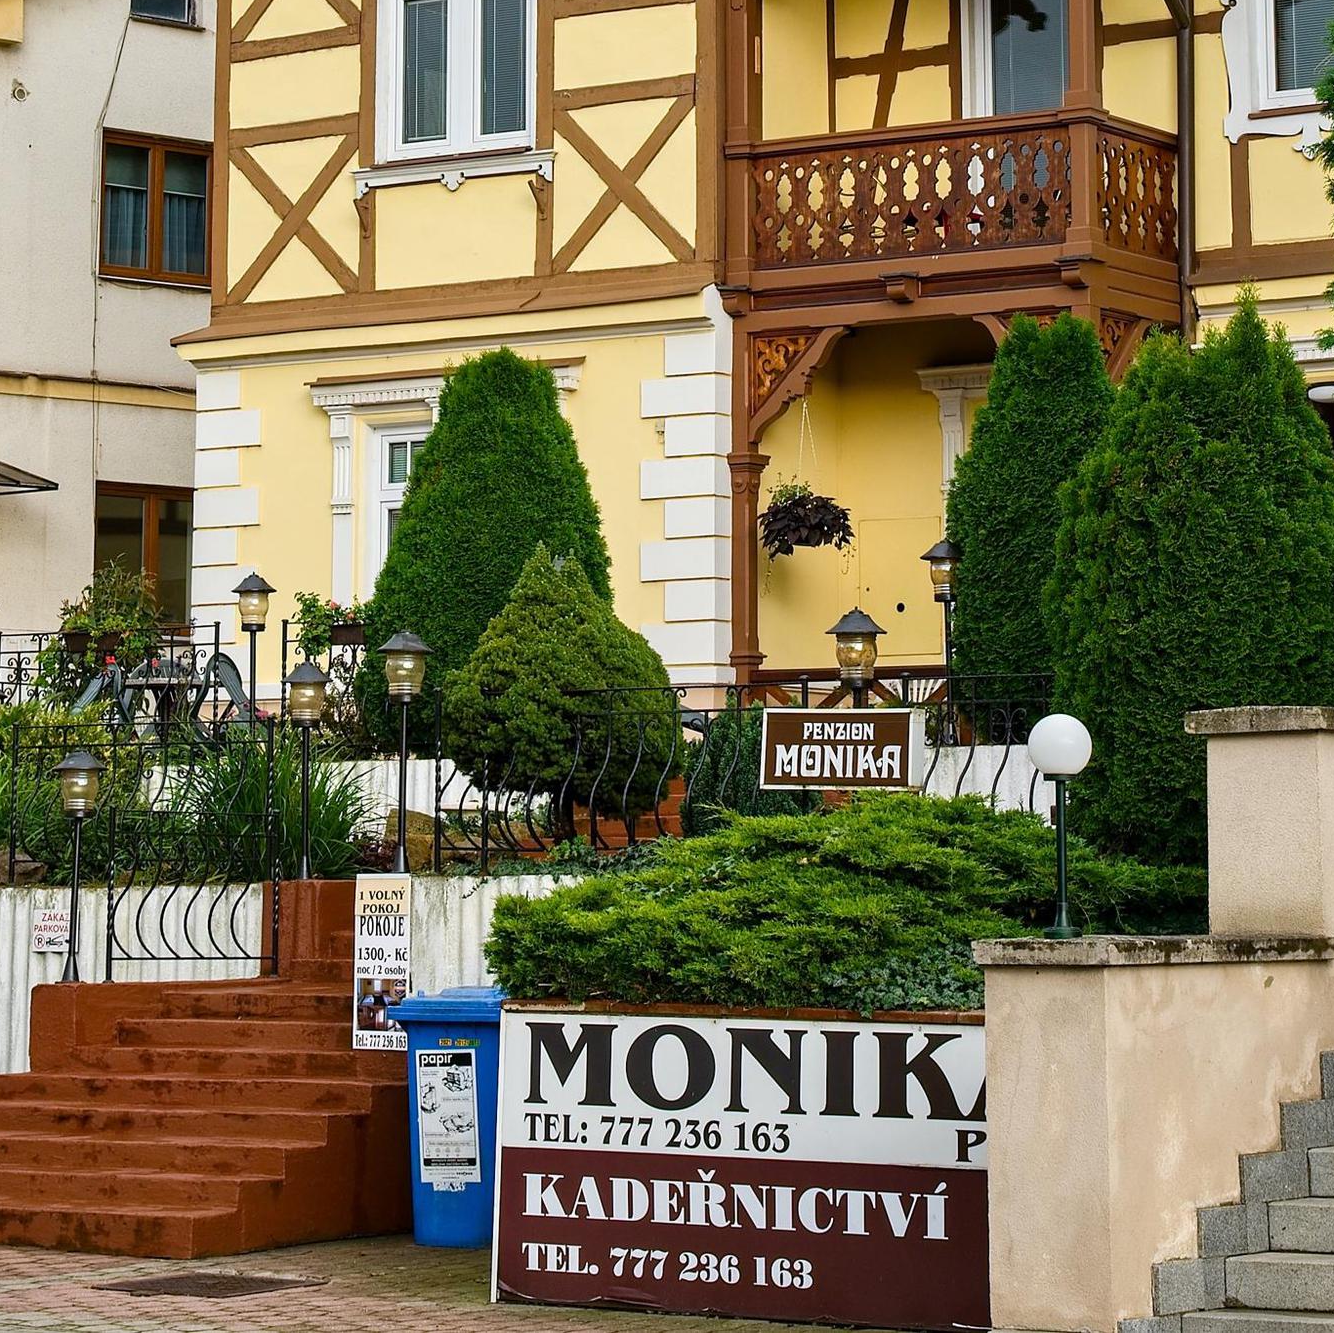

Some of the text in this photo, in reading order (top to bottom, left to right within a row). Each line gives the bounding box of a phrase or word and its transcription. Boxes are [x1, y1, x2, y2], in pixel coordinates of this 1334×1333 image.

[803, 723, 875, 740] PENZION
[774, 744, 902, 779] MONIKA
[359, 886, 405, 900] 1 VOLNÝ
[362, 903, 400, 914] POKOJ
[34, 922, 69, 933] PARKOVÁ
[360, 915, 404, 936] POKOJE
[358, 947, 408, 963] 1300,- Kč
[357, 966, 371, 974] noc
[377, 965, 382, 974] 2
[384, 965, 407, 977] osoby
[369, 1034, 380, 1047] 777
[395, 1035, 407, 1049] 163
[524, 1021, 987, 1122] MONIK
[524, 1113, 791, 1154] TEL: 777 236 163
[522, 1169, 949, 1241] KADEŘNICTVÍ
[522, 1242, 814, 1289] TEL. 777 236 163
